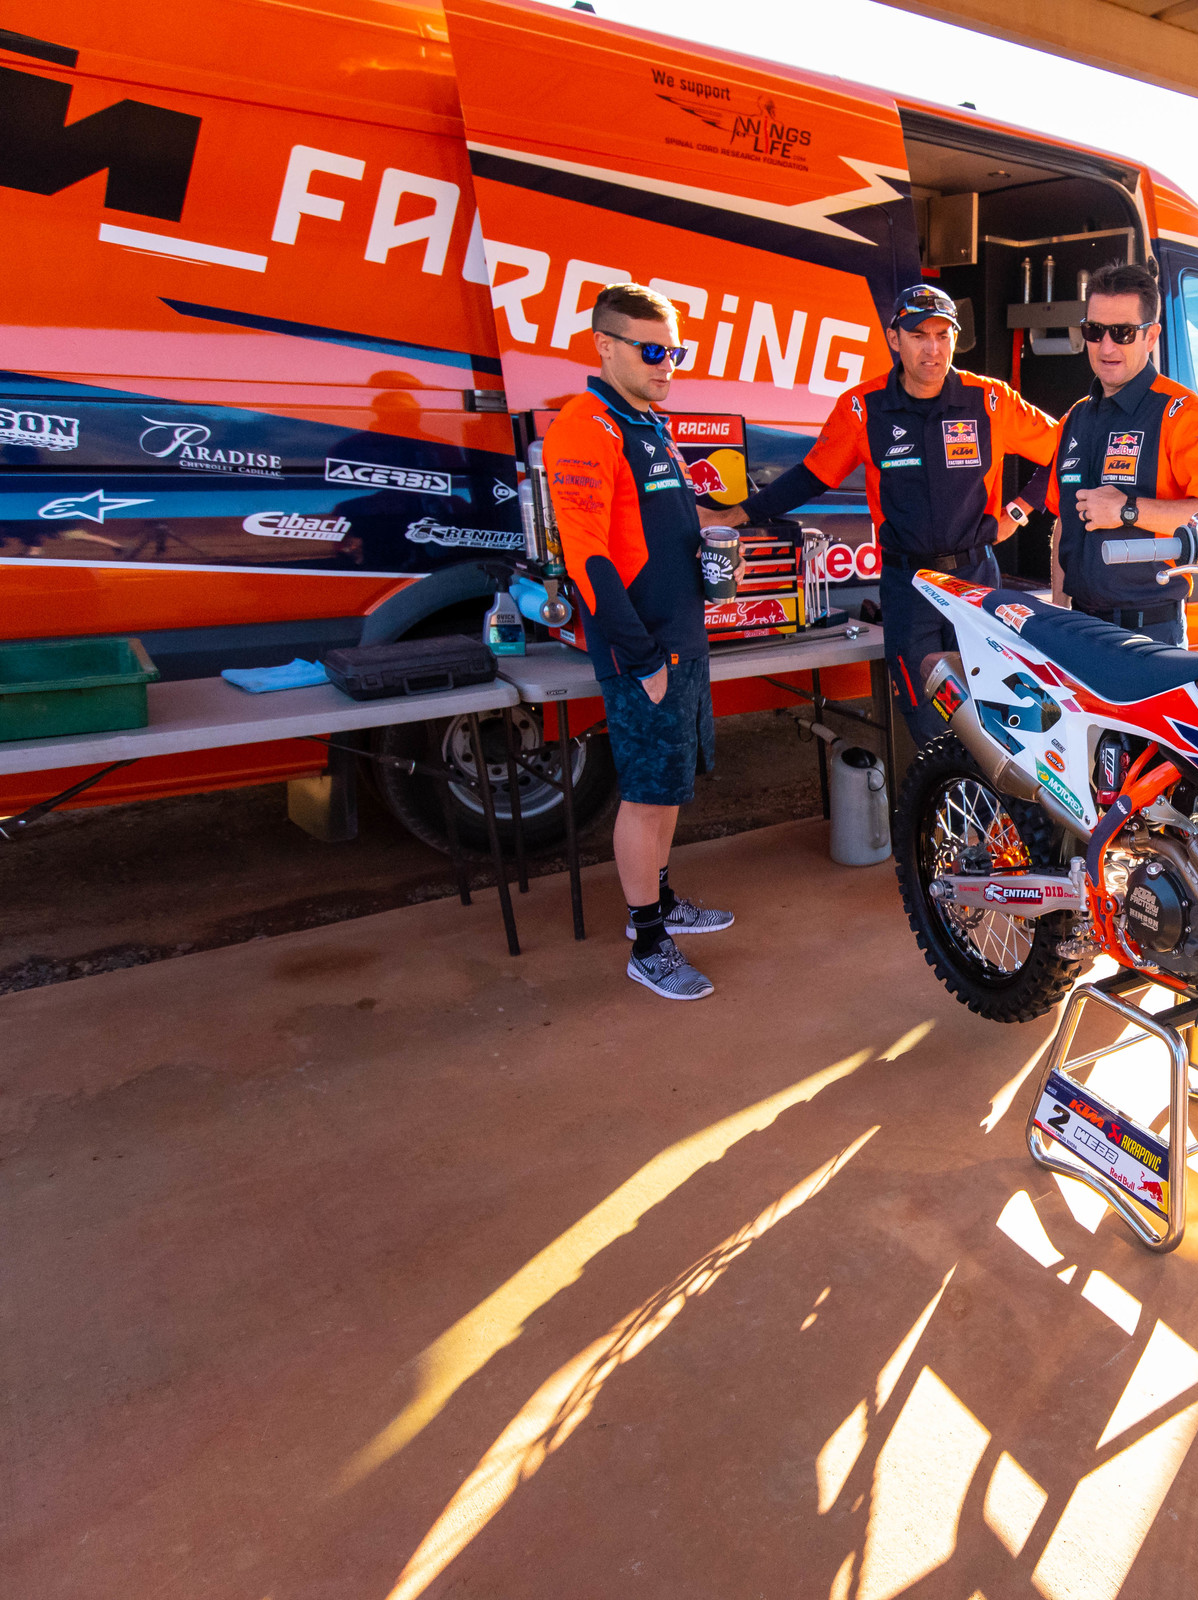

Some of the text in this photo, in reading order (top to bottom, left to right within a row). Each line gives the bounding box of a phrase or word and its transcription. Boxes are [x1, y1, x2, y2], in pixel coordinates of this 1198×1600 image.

[651, 68, 731, 101] We support
[665, 137, 809, 172] SPINAL CORD RESEARCH FOUNDATION
[753, 136, 793, 159] LIFE
[272, 145, 492, 286] FA
[139, 415, 282, 469] PARADISE
[952, 447, 974, 456] KTM
[1106, 444, 1139, 456] Red Bull
[179, 459, 282, 478] CHEVROLET CADILLAC
[1107, 460, 1131, 470] KTM
[242, 511, 352, 541] Eibach
[444, 527, 526, 546] RENTHA
[920, 584, 951, 607] DUNLOP
[974, 672, 1062, 756] 2
[1048, 777, 1084, 816] MOTOREX
[1045, 886, 1063, 898] DID
[1069, 1099, 1105, 1129] KTM
[1047, 1104, 1119, 1165] 2 WEBB
[1109, 1167, 1136, 1192] Red Bull
